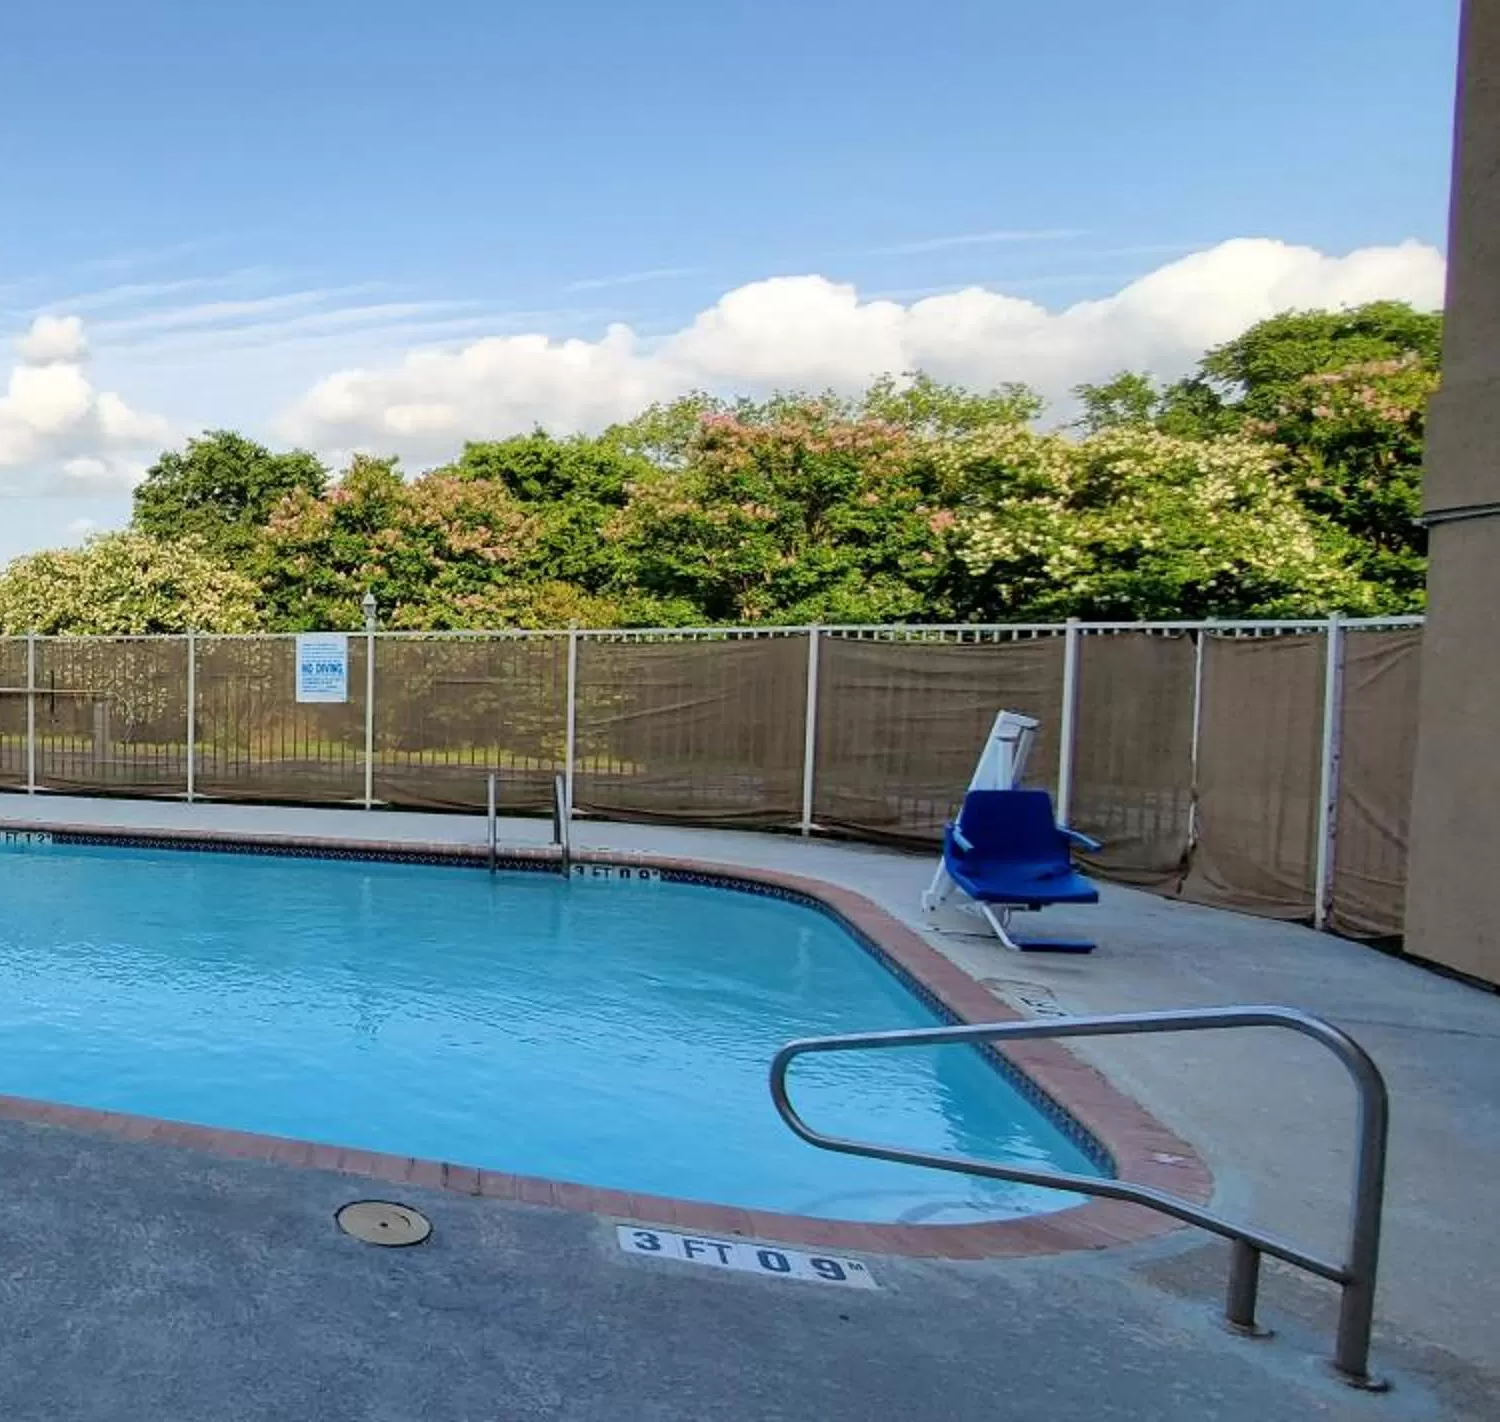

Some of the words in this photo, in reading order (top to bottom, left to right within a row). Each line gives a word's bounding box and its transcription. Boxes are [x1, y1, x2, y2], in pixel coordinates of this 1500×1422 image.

[301, 663, 314, 673] NO
[315, 663, 343, 675] DIVING
[632, 1231, 662, 1251] 3
[682, 1238, 733, 1265] FT
